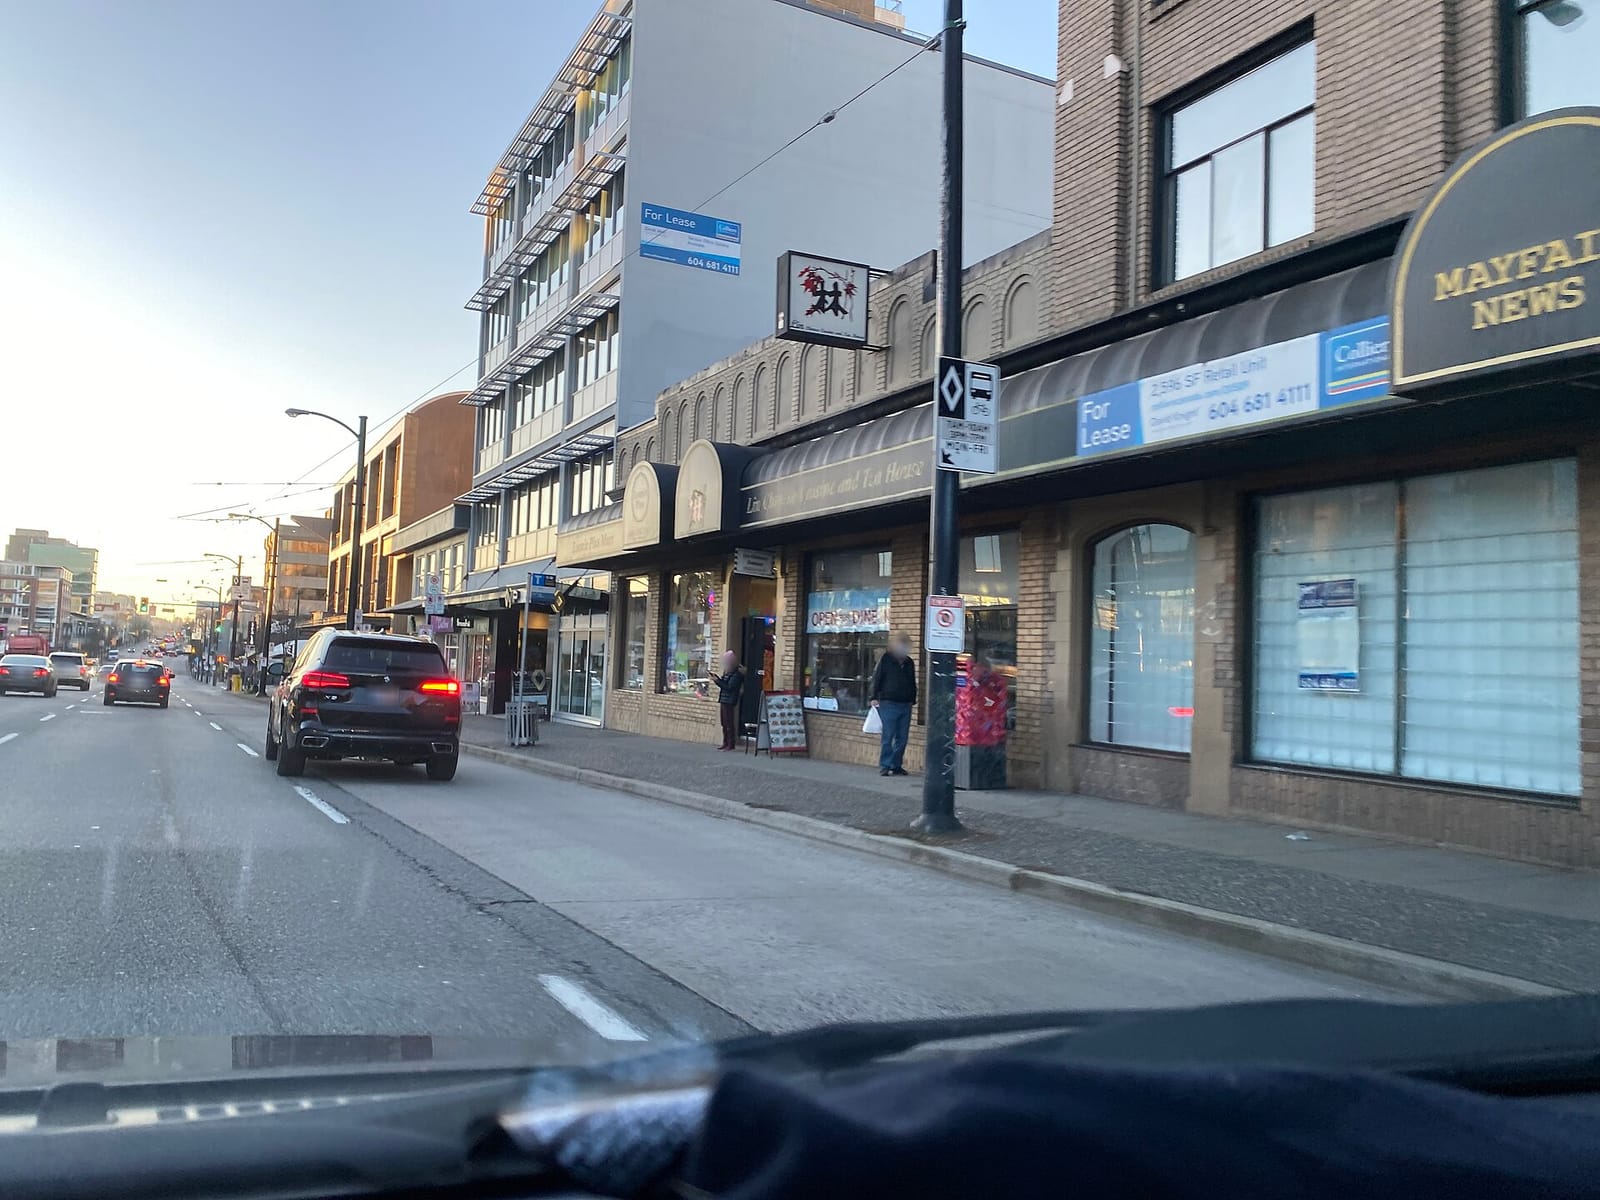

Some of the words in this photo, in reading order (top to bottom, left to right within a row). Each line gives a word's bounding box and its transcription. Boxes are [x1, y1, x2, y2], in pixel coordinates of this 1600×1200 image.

[644, 208, 662, 221] For
[665, 213, 697, 229] Lease
[687, 257, 704, 268] 604
[706, 260, 720, 271] 681
[722, 263, 739, 274] 4111
[1434, 228, 1600, 301] MAYFAI
[1471, 275, 1586, 330] NEWS
[1334, 340, 1391, 364] Collier
[1203, 361, 1240, 382] Retail
[1081, 401, 1111, 424] For
[1207, 400, 1239, 420] 604
[1243, 391, 1272, 413] 681
[1275, 383, 1312, 407] 4111
[1081, 423, 1132, 449] Lease
